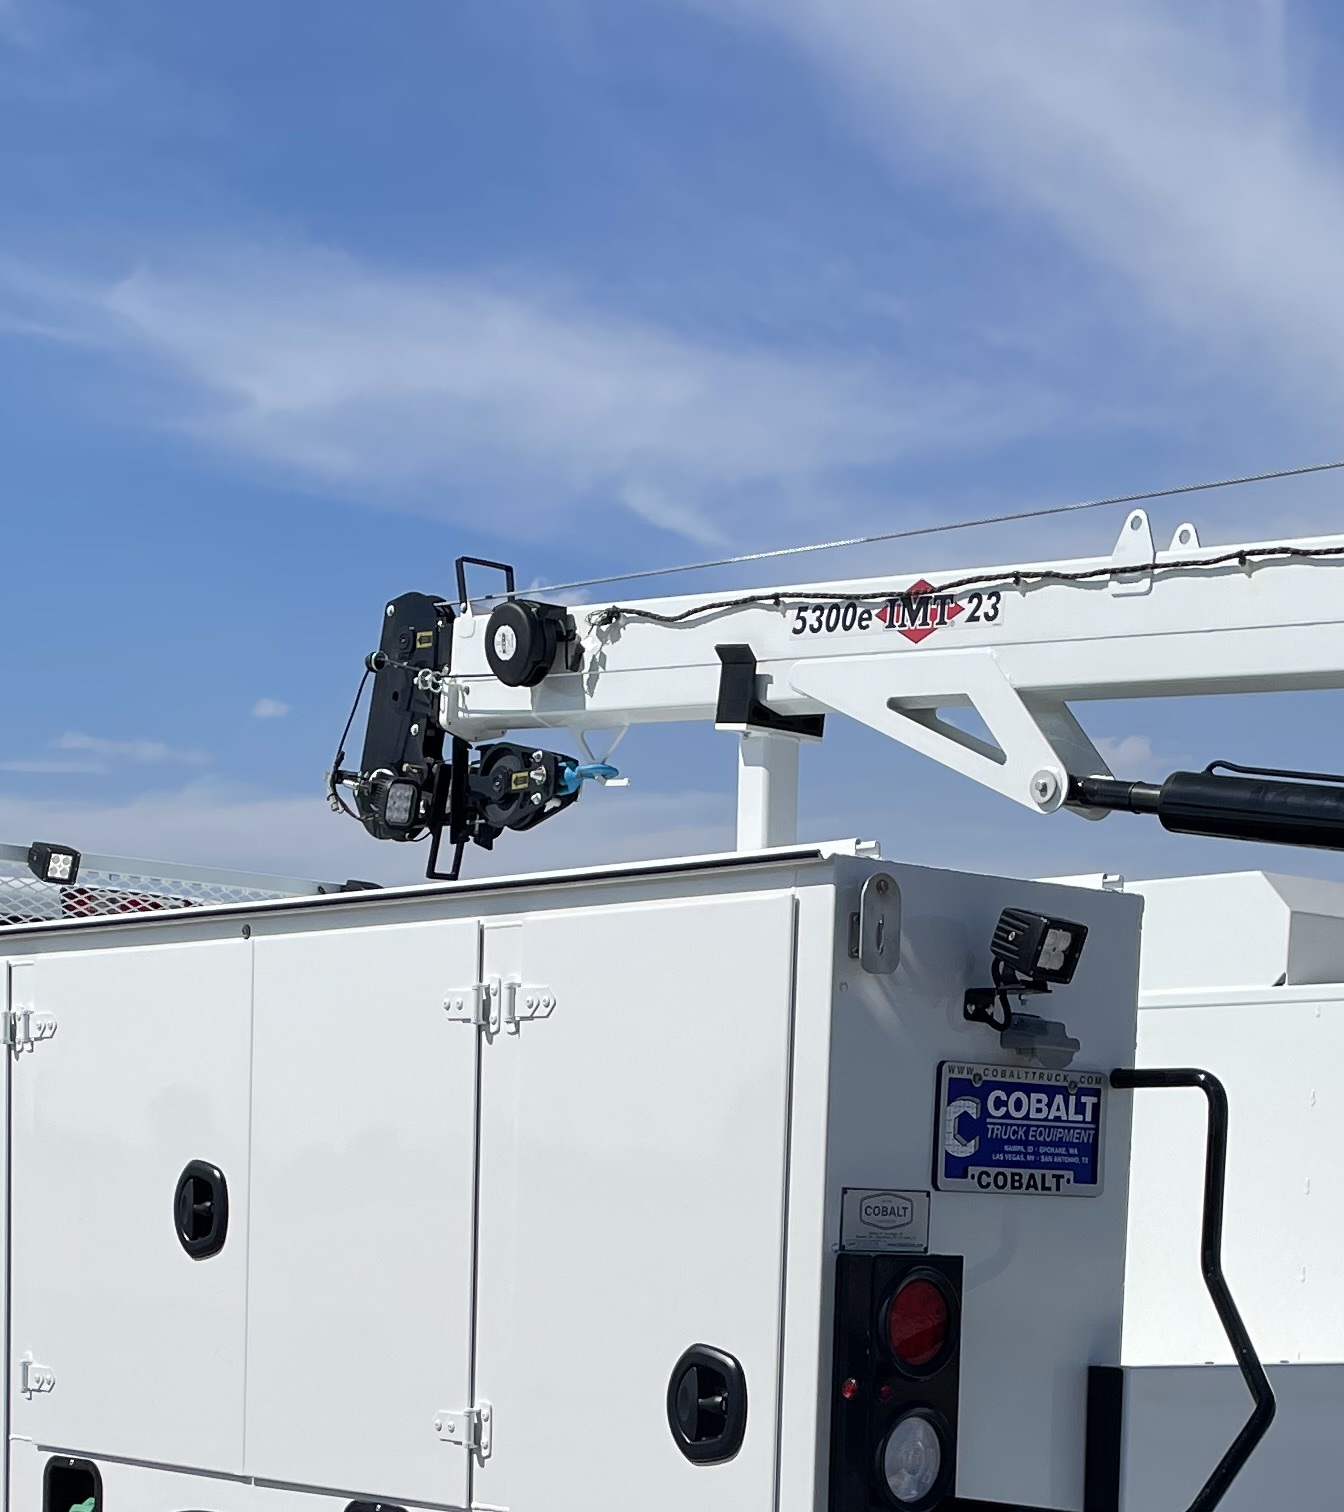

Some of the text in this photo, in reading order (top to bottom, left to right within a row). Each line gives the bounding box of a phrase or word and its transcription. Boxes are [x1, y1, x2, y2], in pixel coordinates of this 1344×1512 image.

[791, 590, 1002, 636] 5300e IMT 23
[987, 1089, 1099, 1122] COBALT
[987, 1123, 1096, 1144] TRUCK EQUIPMENT
[976, 1170, 1065, 1192] COBALT
[864, 1205, 909, 1217] COBALT
